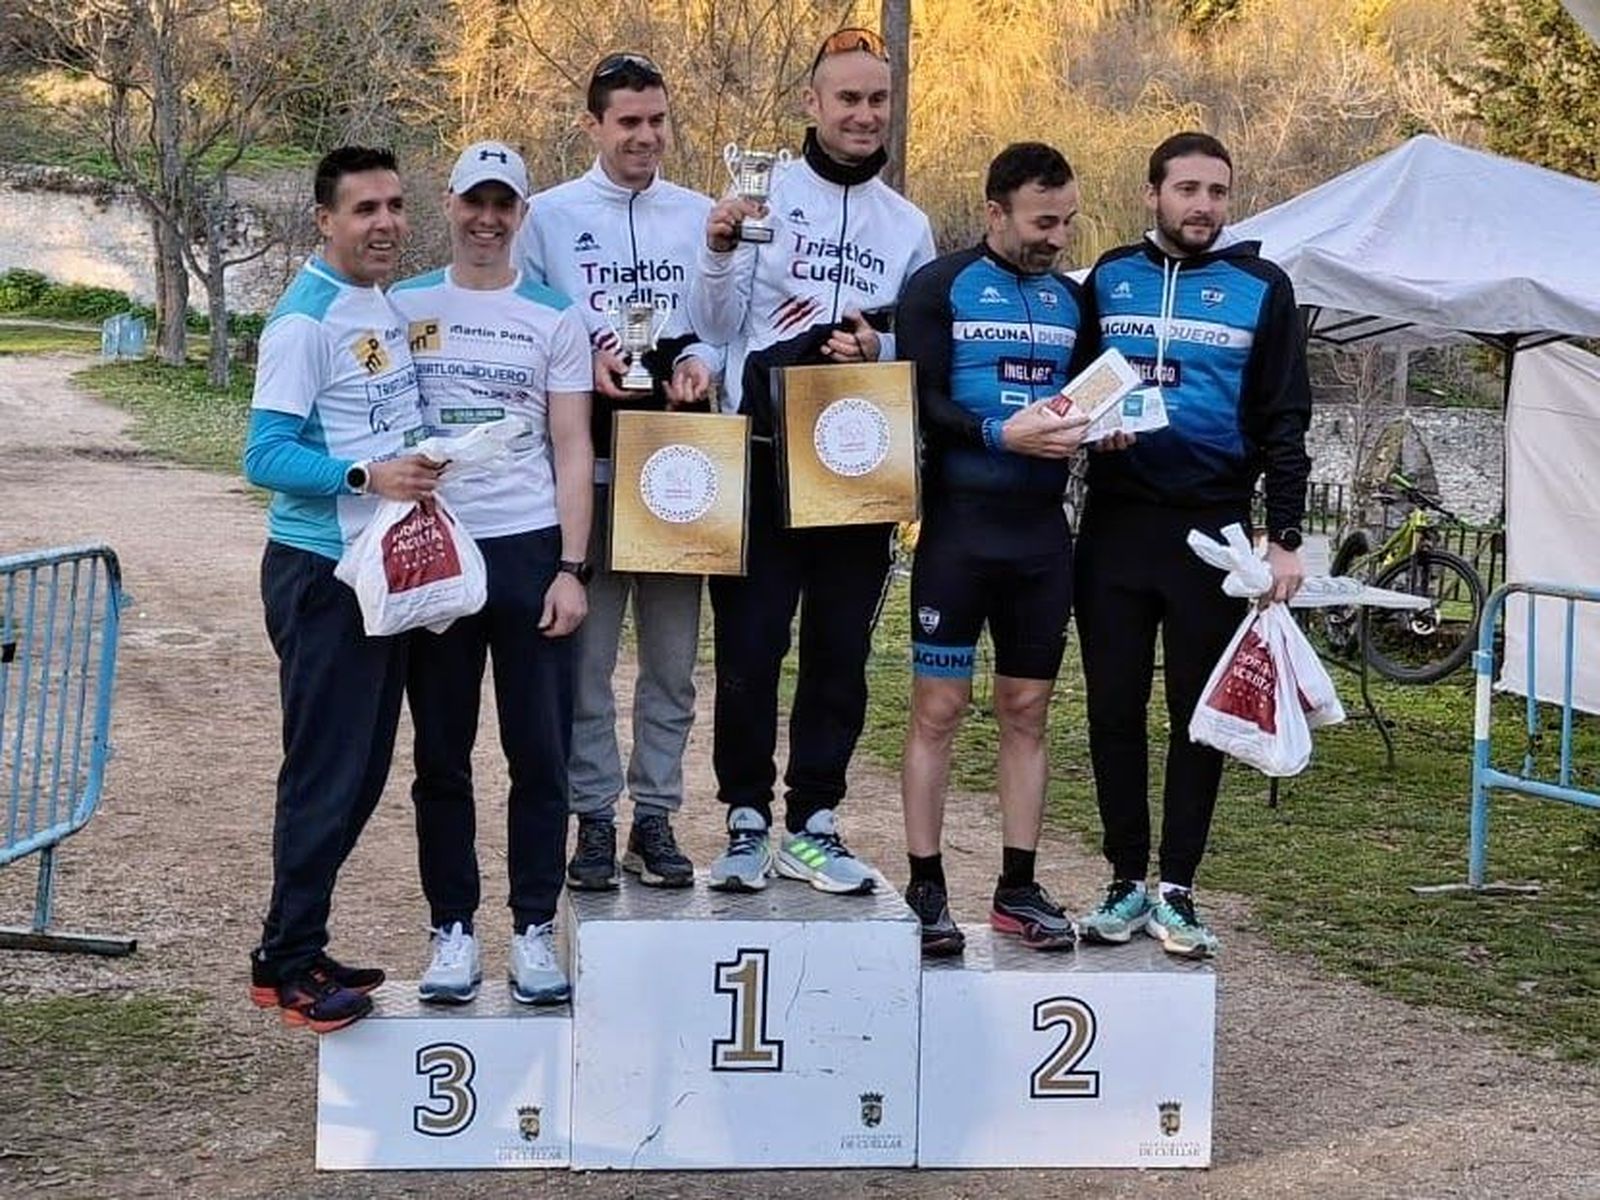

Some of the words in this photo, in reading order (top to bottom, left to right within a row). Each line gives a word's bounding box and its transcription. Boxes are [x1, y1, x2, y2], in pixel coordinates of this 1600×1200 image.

[580, 259, 684, 284] Triatlón
[792, 231, 884, 275] Triatlón
[963, 327, 1031, 341] LAGUNA
[1166, 324, 1231, 345] DUERO
[711, 948, 784, 1072] 1
[1030, 996, 1100, 1099] 2
[414, 1041, 477, 1137] 3
